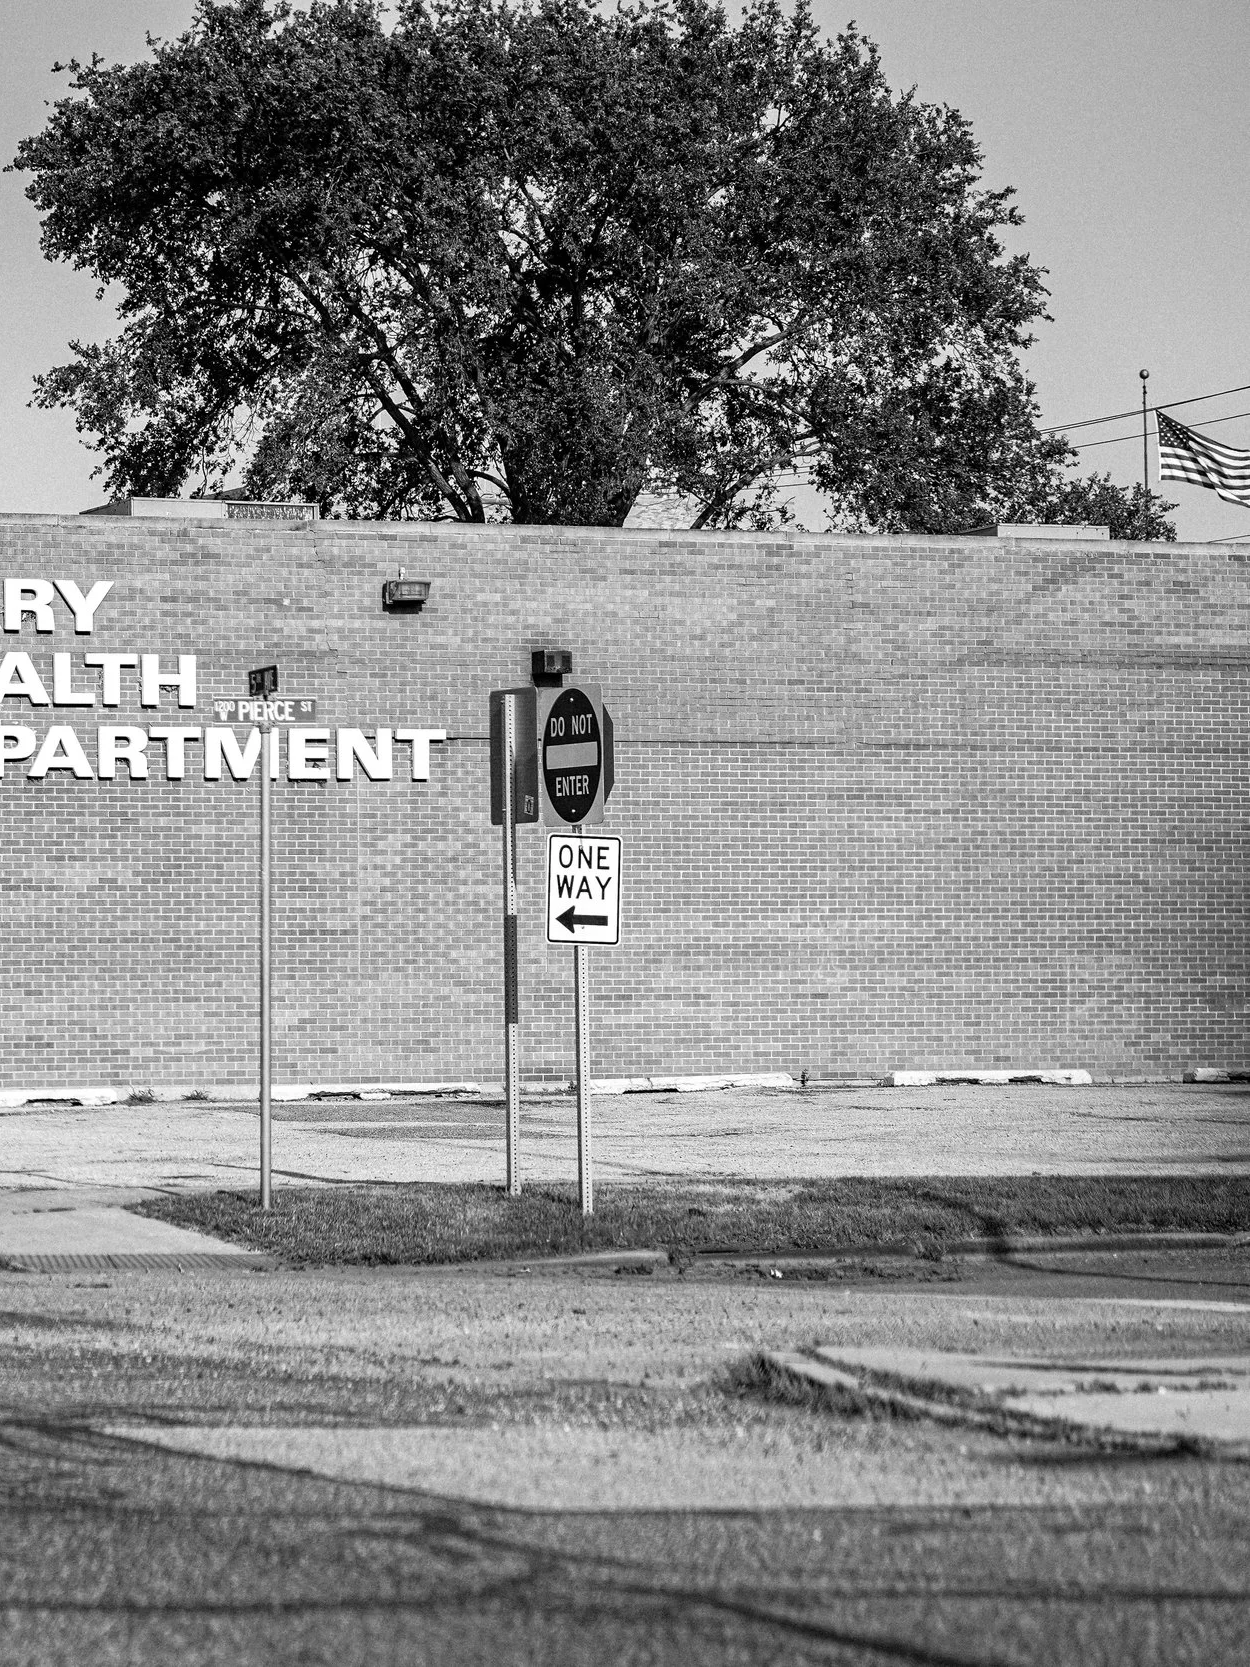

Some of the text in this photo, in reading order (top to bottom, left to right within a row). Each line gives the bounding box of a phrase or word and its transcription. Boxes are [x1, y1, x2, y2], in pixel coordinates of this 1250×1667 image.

[214, 700, 236, 712] 1200
[219, 711, 228, 721] W
[237, 701, 313, 721] PIERCE ST
[550, 713, 593, 738] DO NOT
[555, 774, 590, 797] ENTER
[558, 844, 610, 870] ONE
[556, 874, 612, 900] WAY
